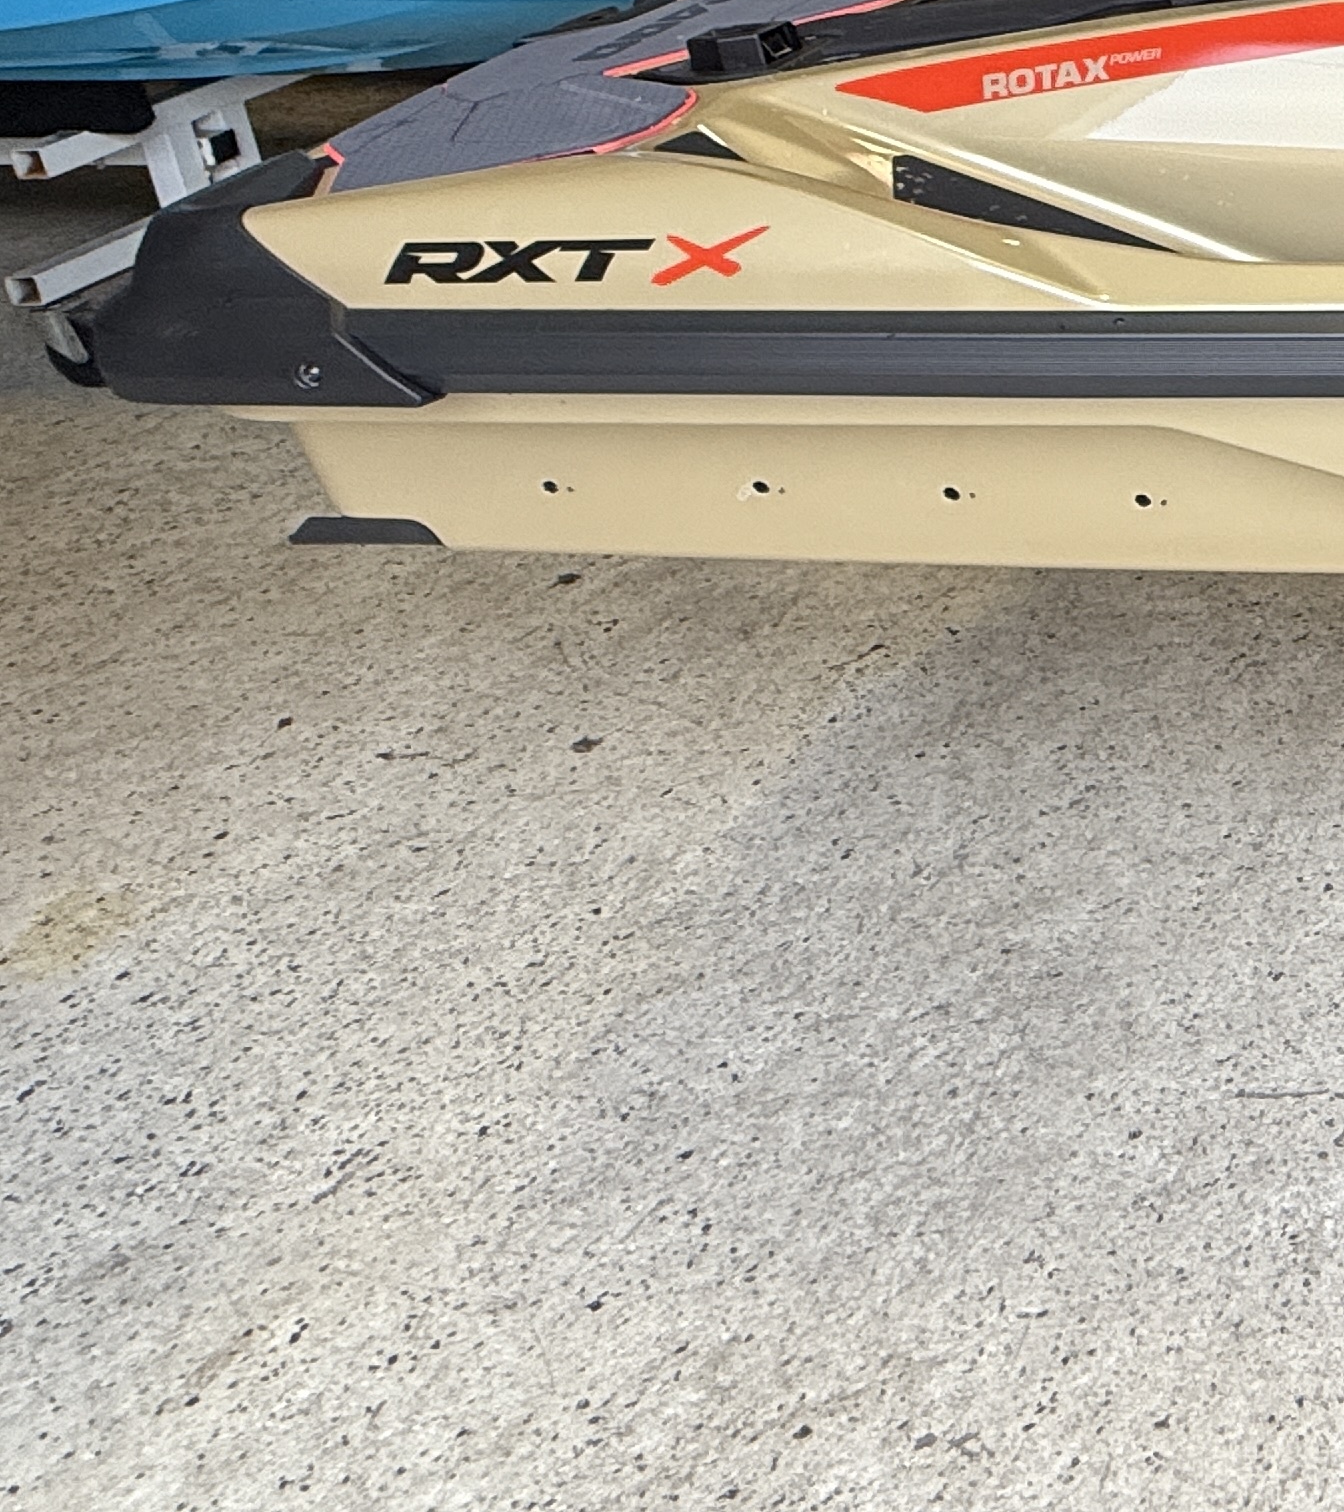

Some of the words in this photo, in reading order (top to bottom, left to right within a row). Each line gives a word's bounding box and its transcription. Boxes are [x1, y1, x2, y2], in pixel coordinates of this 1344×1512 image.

[982, 55, 1111, 100] ROTAX
[1109, 47, 1162, 66] POWER
[383, 238, 657, 285] RXT
[650, 225, 772, 287] X
